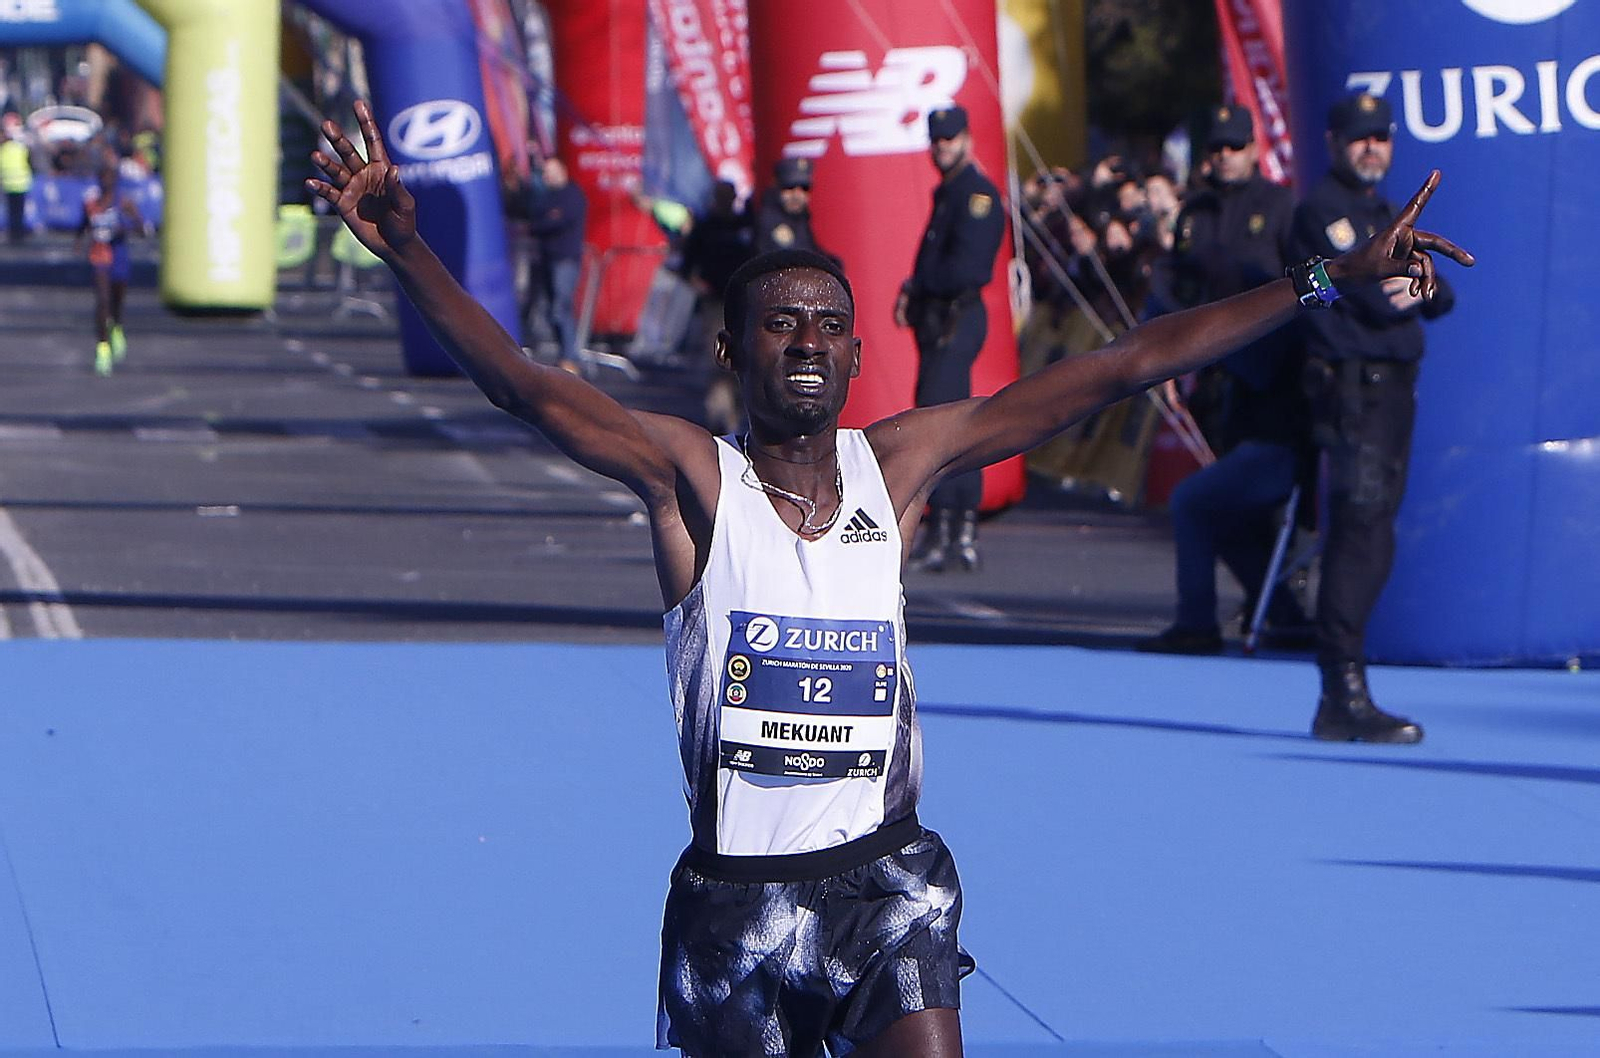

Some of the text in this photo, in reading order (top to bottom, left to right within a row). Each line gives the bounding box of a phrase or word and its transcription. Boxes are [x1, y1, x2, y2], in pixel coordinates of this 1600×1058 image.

[840, 529, 888, 544] adidas
[784, 627, 878, 652] ZURICH
[798, 676, 833, 703] 12
[761, 720, 854, 743] MEKUANT
[846, 766, 878, 777] ZURICH
